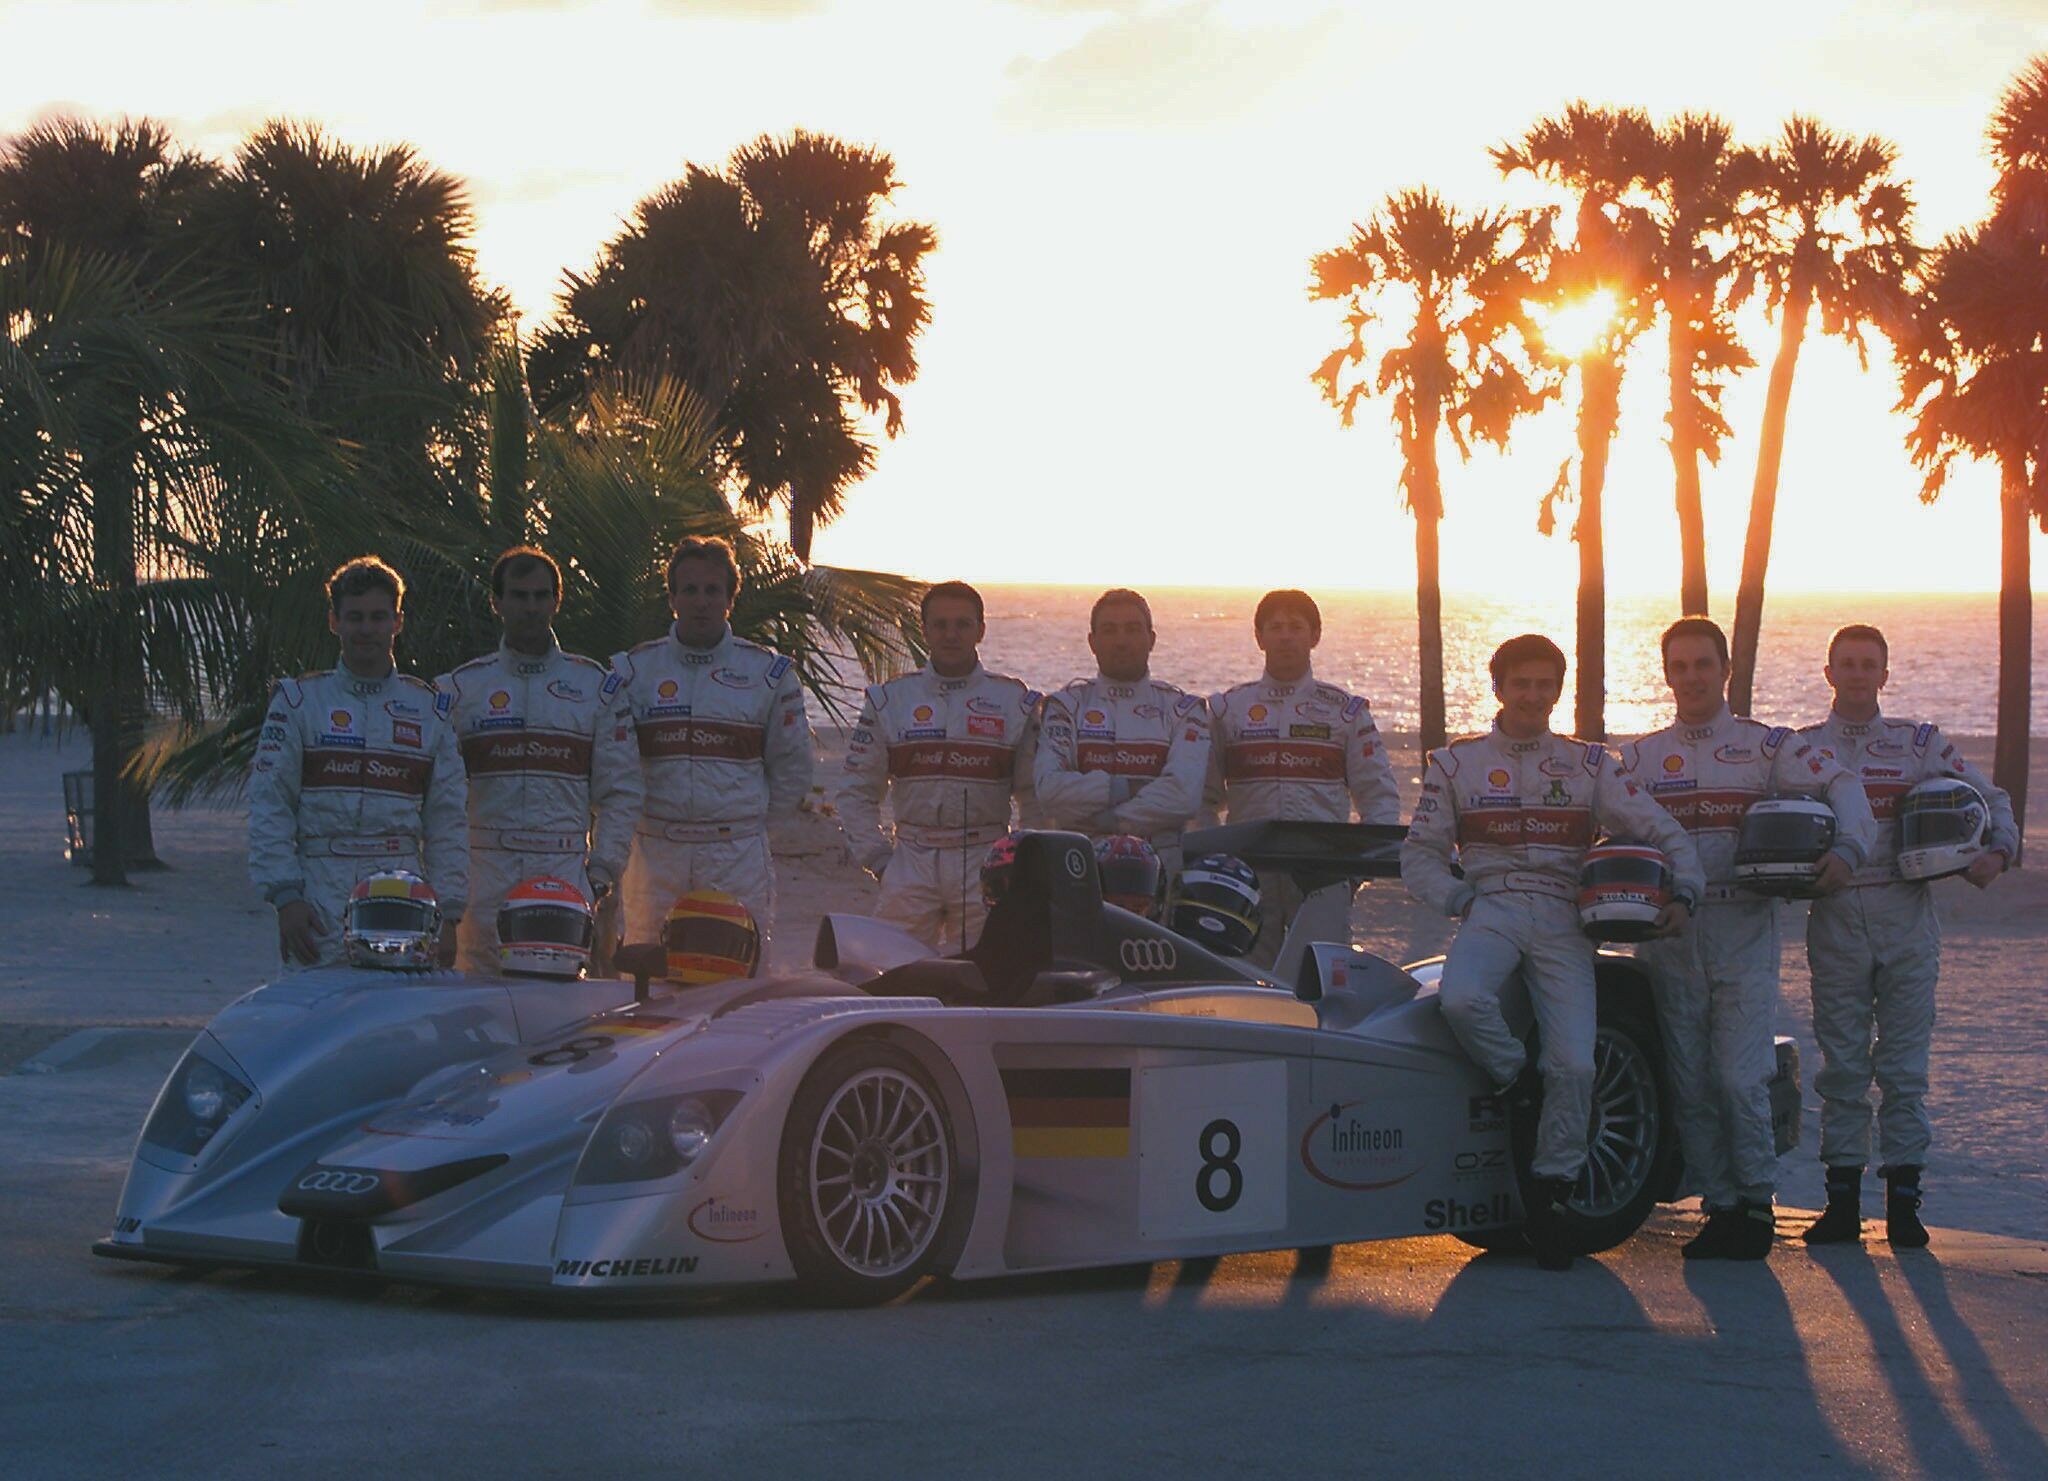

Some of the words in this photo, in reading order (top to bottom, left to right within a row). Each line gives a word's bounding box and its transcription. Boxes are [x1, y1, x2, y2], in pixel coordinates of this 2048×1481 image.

[654, 727, 689, 743] Audi
[691, 728, 736, 747] Sport
[489, 743, 525, 757] Audi
[526, 740, 571, 760] Sport
[911, 751, 944, 765] Audi
[947, 751, 991, 768] Sport
[1115, 751, 1157, 766] Sport
[1280, 751, 1323, 768] Sport
[323, 758, 362, 775] Audi
[366, 759, 411, 779] Sport
[1698, 799, 1745, 817] Sport
[1525, 817, 1569, 835] Sport
[1332, 1119, 1403, 1153] Infineon
[1195, 1118, 1244, 1213] 8
[709, 1204, 757, 1223] Infineon
[1423, 1193, 1511, 1231] Shell
[555, 1257, 699, 1277] MICHELIN
